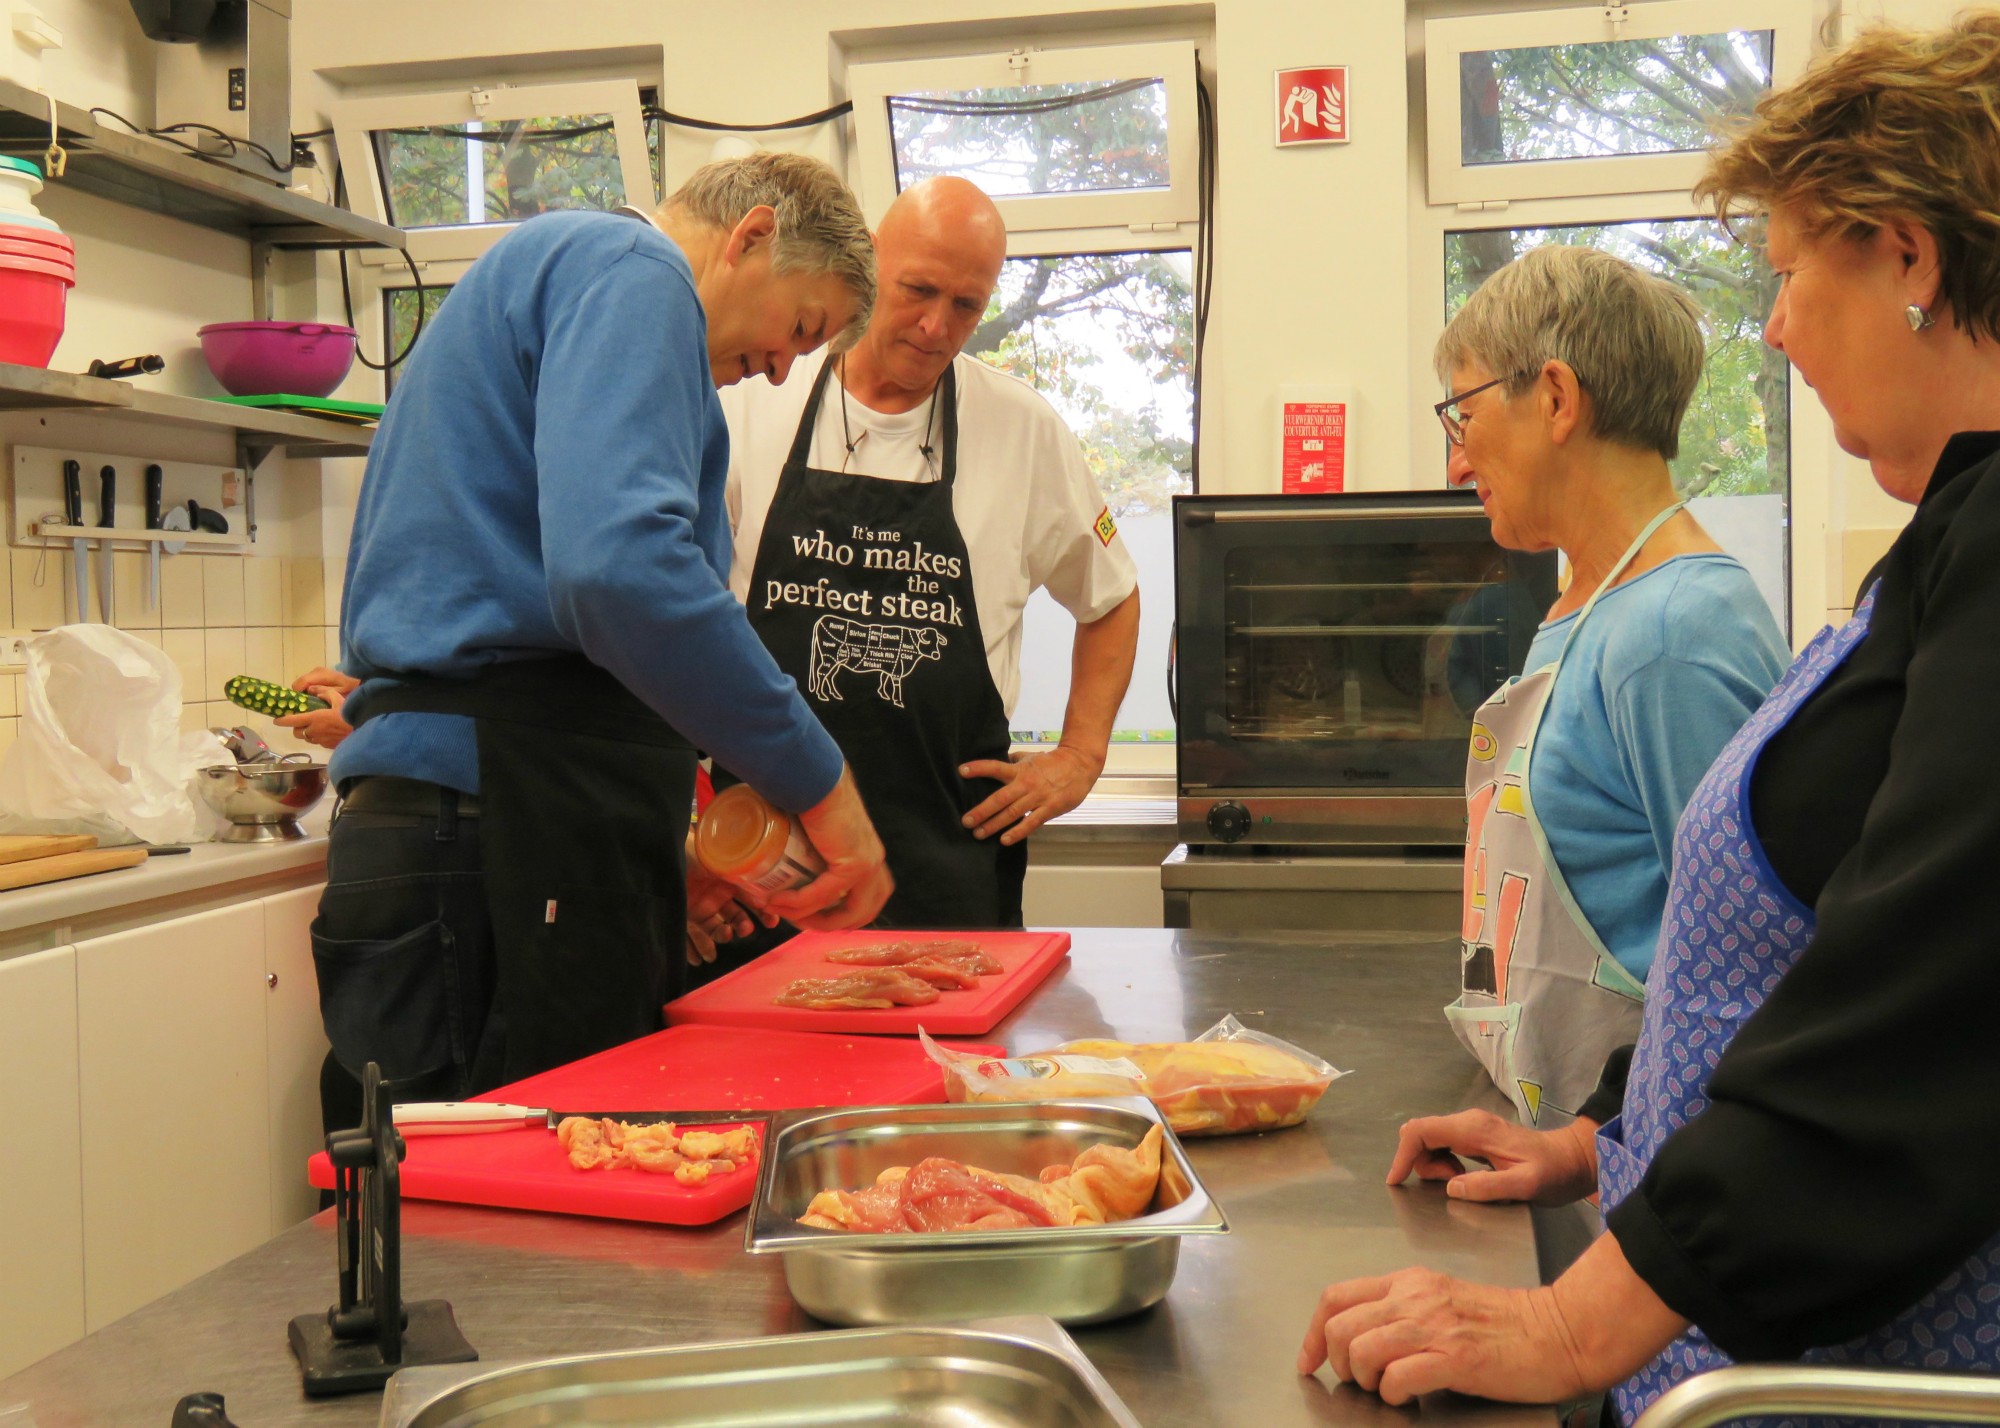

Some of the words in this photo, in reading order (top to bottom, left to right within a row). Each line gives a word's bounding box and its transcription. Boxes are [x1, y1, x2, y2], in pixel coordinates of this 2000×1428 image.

[1285, 426, 1319, 436] COUVERTURE
[851, 525, 874, 541] It's
[877, 530, 901, 542] me
[792, 529, 854, 566] who
[862, 541, 961, 579] makes
[907, 574, 939, 594] the
[764, 577, 873, 616] perfect
[881, 592, 964, 627] steak
[829, 623, 845, 631] Rump
[869, 650, 884, 658] Thick
